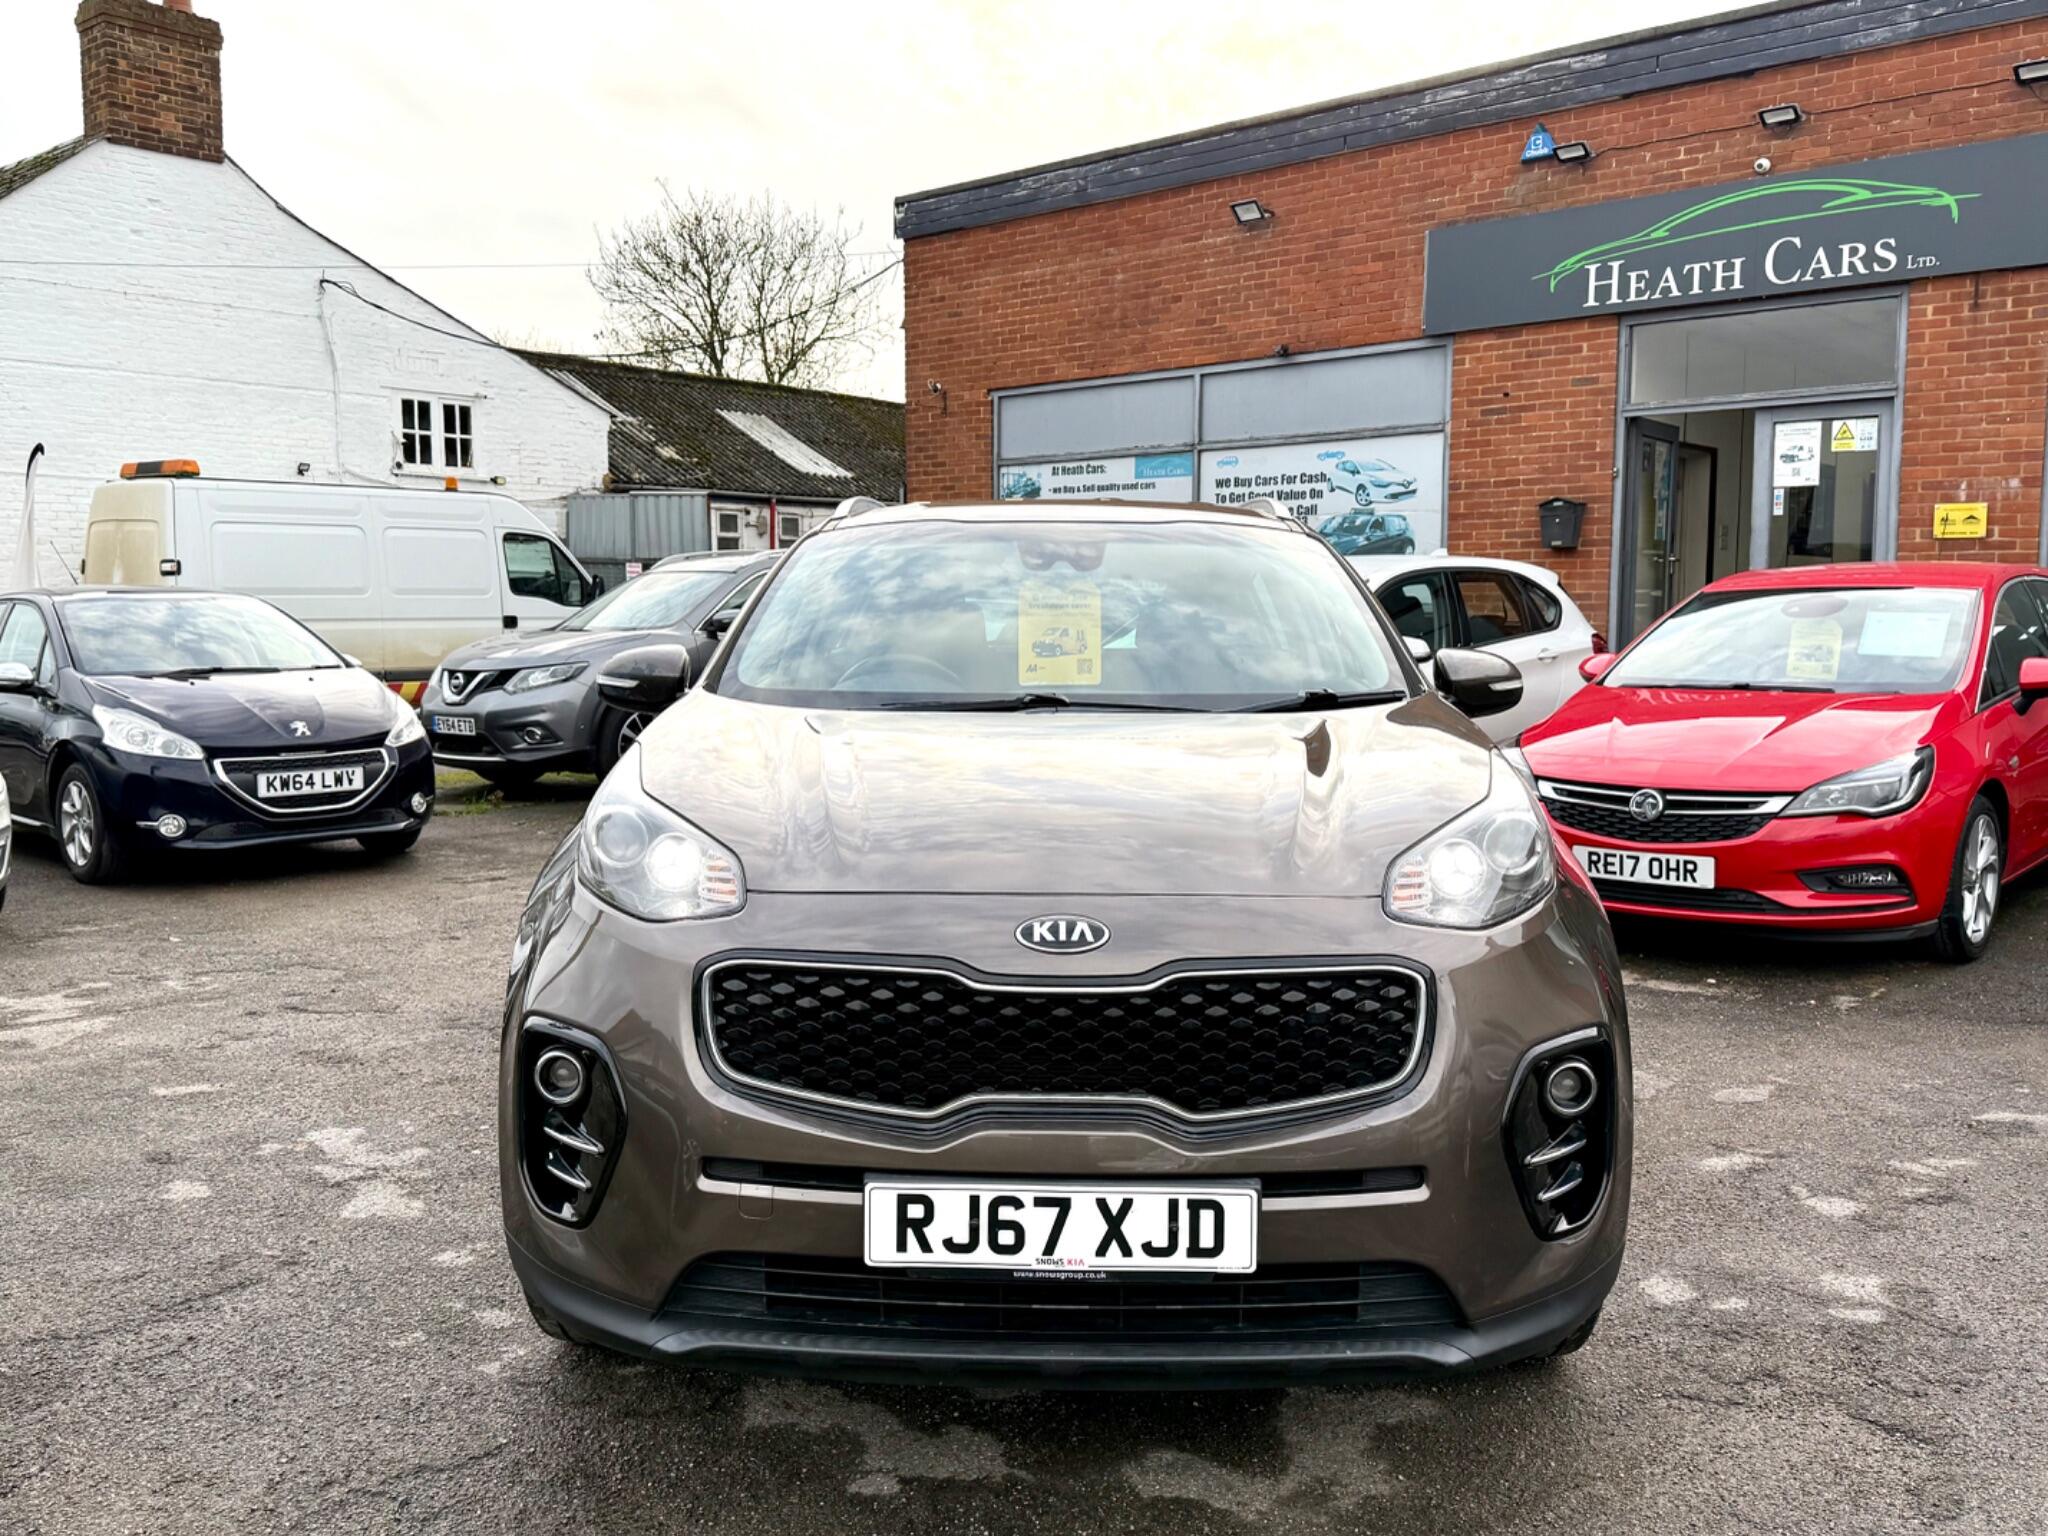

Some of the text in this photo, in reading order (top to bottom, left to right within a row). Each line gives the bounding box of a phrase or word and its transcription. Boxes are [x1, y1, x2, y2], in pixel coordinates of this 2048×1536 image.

[1582, 257, 1746, 308] HEATH
[1764, 236, 1898, 285] CARS
[1051, 463, 1107, 476] At Heath Cars:
[1052, 486, 1062, 494] we
[1063, 485, 1076, 495] Buy
[1082, 483, 1096, 493] Sell
[1097, 482, 1120, 493] quality
[1121, 482, 1140, 491] used
[1140, 481, 1156, 490] cars
[1215, 471, 1327, 489] we Buy Cars For Cash
[1215, 493, 1227, 504] To
[1229, 491, 1246, 503] Get
[1277, 489, 1307, 501] Value
[1309, 488, 1323, 499] On
[1296, 503, 1318, 516] Call
[266, 769, 356, 793] KW64 LWV
[1587, 850, 1698, 884] RE17 OHR
[1032, 920, 1095, 942] KIA
[895, 1193, 1225, 1259] RJ67 XJD
[1035, 1258, 1085, 1267] SNOWS KIA
[1013, 1270, 1107, 1280] www.snowsgroup.co.uk
